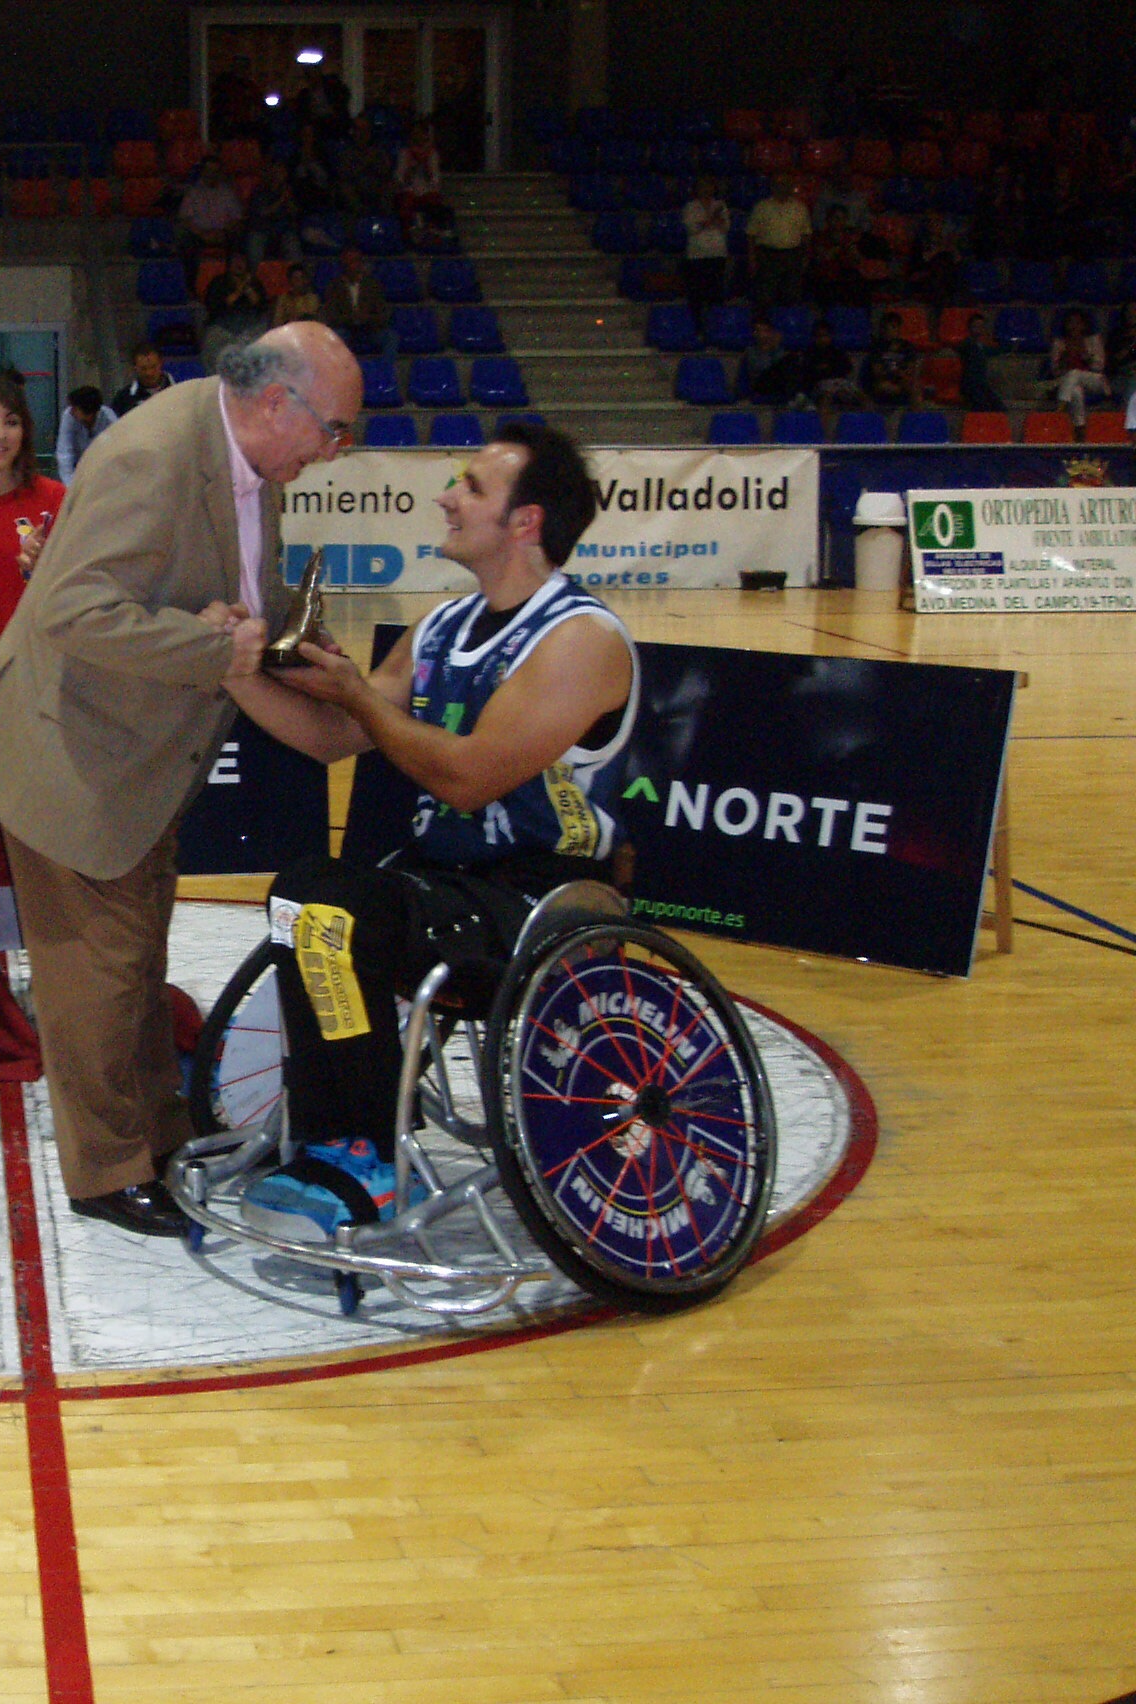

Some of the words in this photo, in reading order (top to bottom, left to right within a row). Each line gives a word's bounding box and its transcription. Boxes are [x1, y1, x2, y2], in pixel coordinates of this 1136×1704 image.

[281, 480, 414, 514] miento
[594, 476, 788, 512] Valladolid
[982, 498, 1070, 526] ORTOPEDIA
[576, 541, 720, 559] Municipal
[1004, 597, 1030, 609] DEL
[664, 779, 893, 856] NORTE
[578, 991, 698, 1060] MICHELIN
[570, 1175, 690, 1240] MICHELIN
